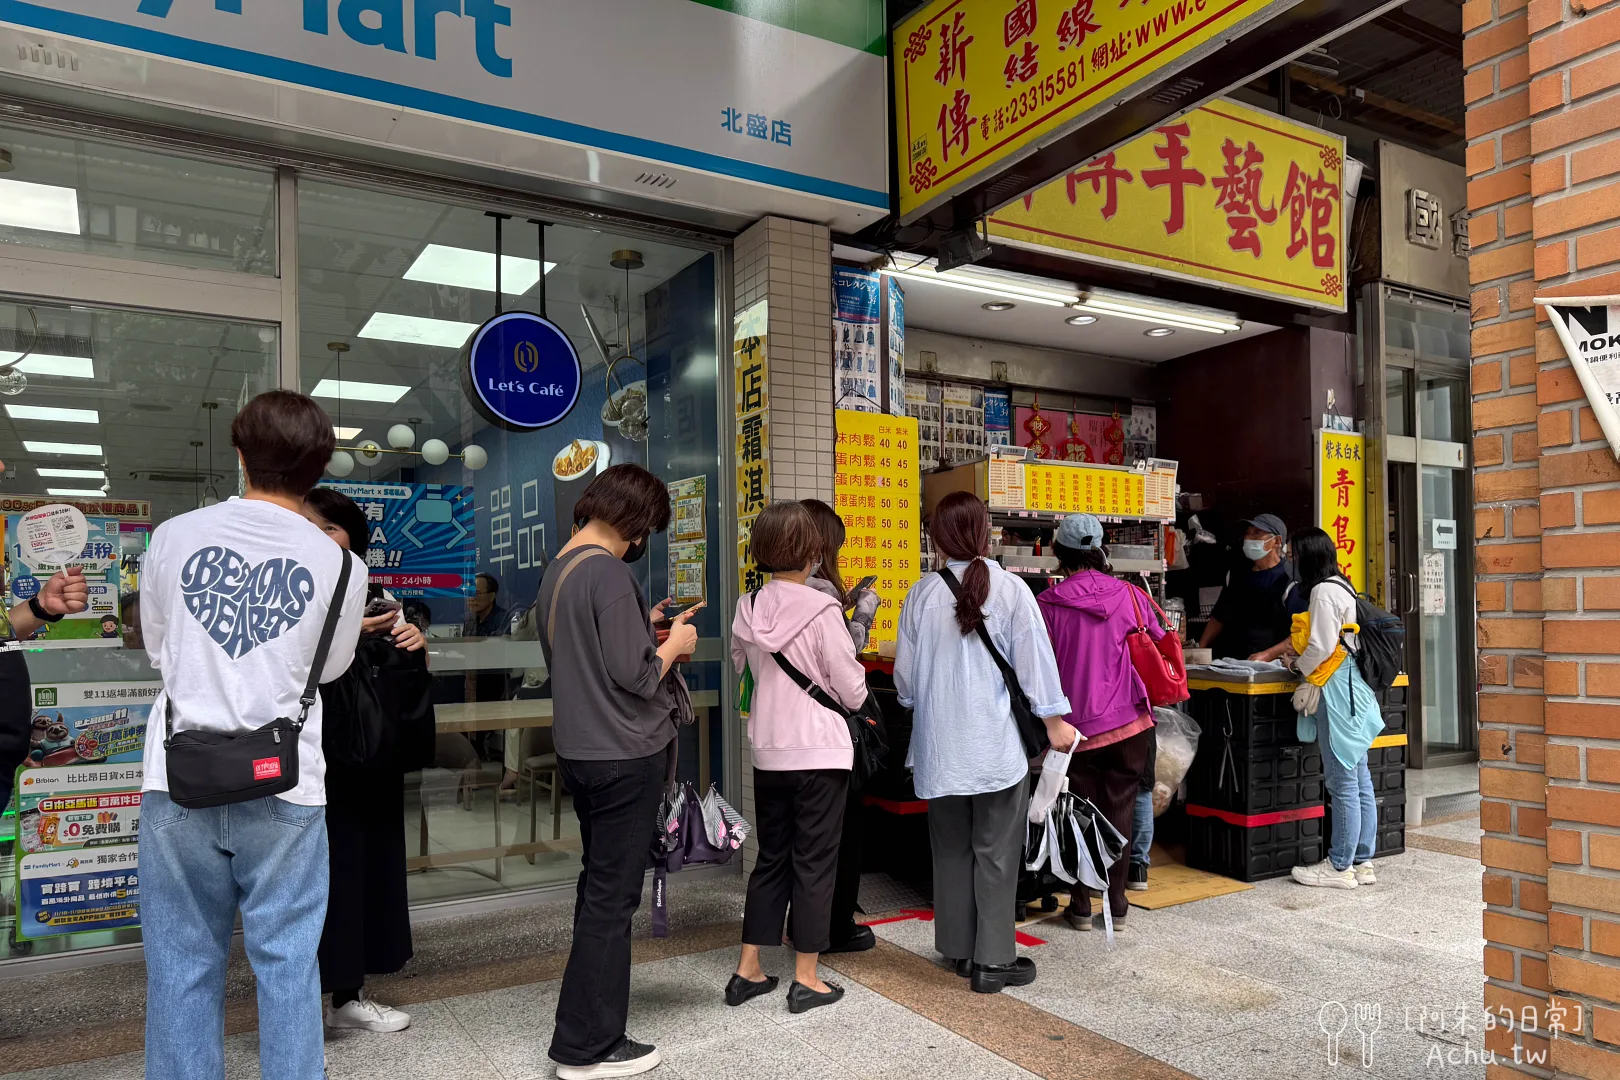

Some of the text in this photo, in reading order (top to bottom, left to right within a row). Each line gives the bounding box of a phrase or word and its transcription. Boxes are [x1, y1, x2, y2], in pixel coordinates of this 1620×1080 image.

[933, 11, 978, 163] 薪傳
[721, 106, 792, 147] 北盛店
[488, 377, 564, 398] Let's Café
[878, 425, 892, 435] 白米
[879, 438, 890, 449] 40
[897, 439, 908, 450] 40
[1325, 439, 1361, 461] 紫米白米
[835, 451, 908, 469] 蛋肉鬆 45 45
[835, 472, 908, 489] 蛋肉鬆 45 45
[383, 488, 406, 497] SEGA
[880, 498, 891, 509] 50
[898, 499, 909, 509] 50
[1045, 502, 1053, 510] 50
[1099, 505, 1106, 513] 50
[1111, 506, 1119, 514] 50
[881, 518, 892, 529] 50
[898, 520, 909, 529] 50
[881, 539, 892, 549] 45
[897, 540, 908, 550] 45
[882, 558, 893, 569] 55
[898, 559, 909, 569] 55
[180, 545, 315, 620] BEAMS
[882, 579, 893, 589] 55
[898, 579, 909, 589] 55
[881, 598, 892, 609] 50
[182, 592, 301, 661] HEART
[882, 619, 892, 629] 60
